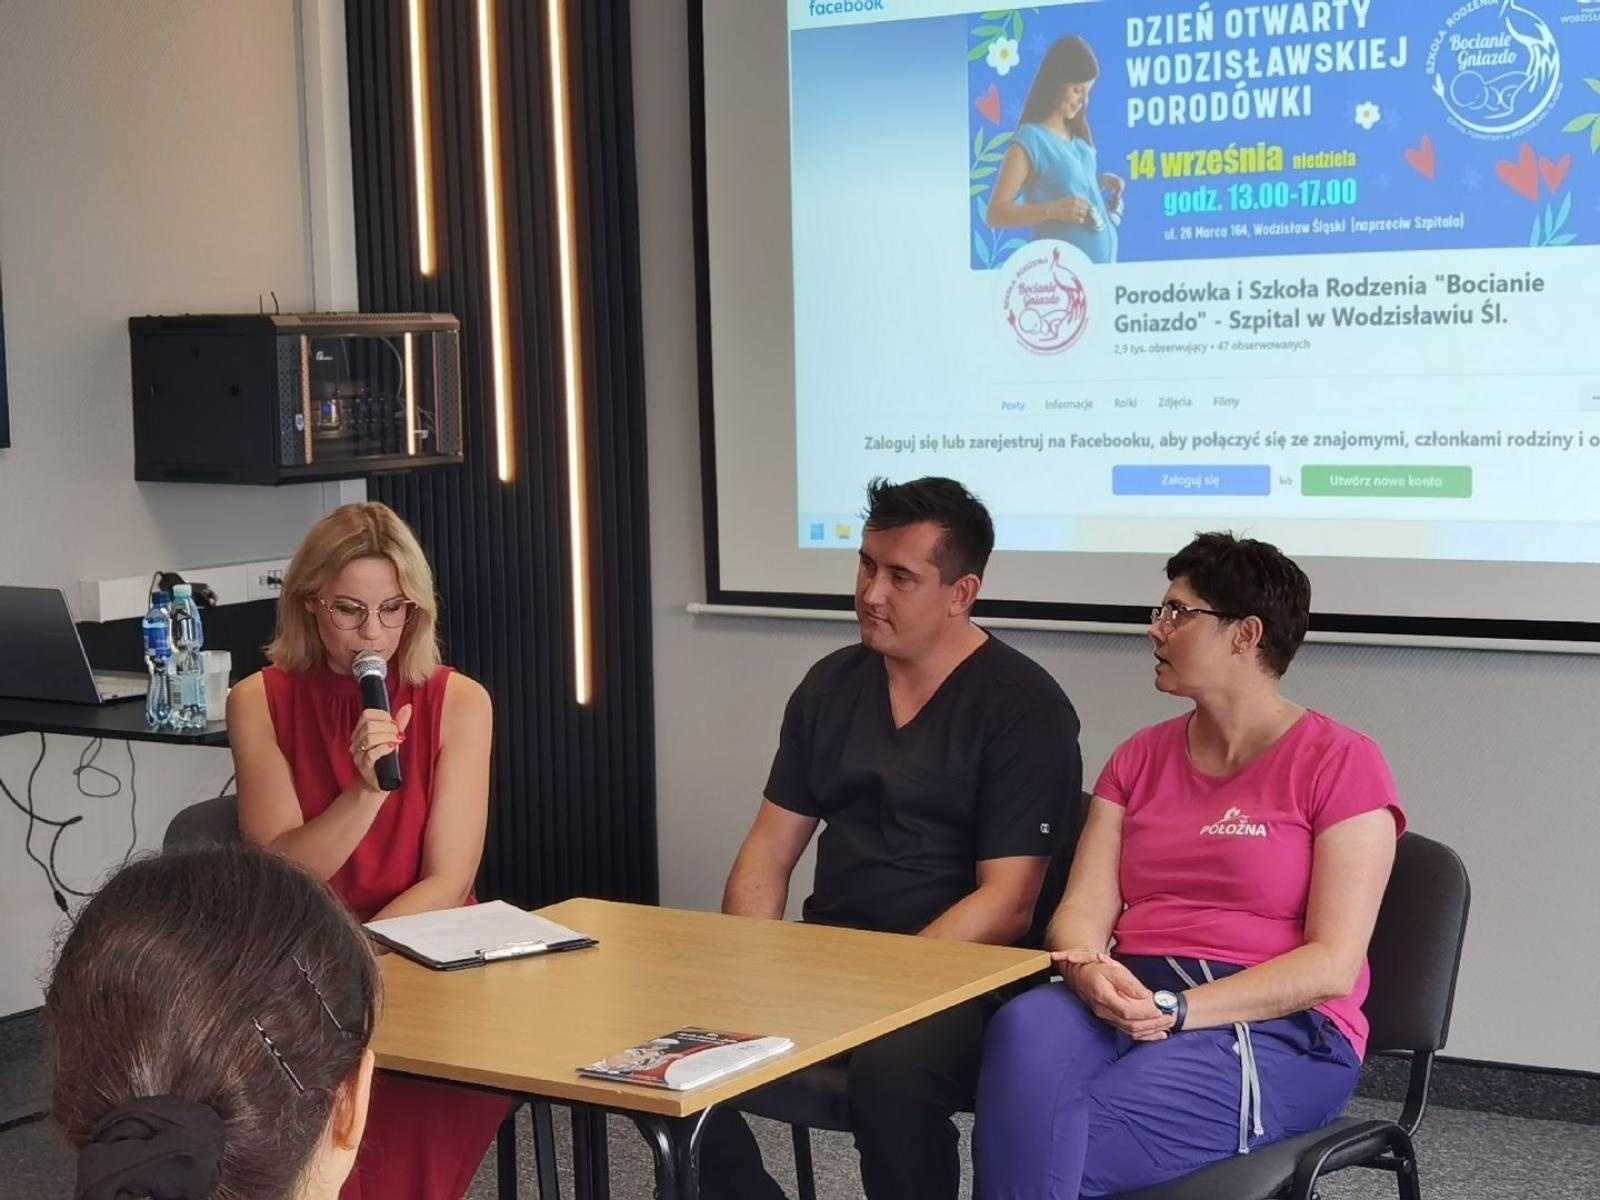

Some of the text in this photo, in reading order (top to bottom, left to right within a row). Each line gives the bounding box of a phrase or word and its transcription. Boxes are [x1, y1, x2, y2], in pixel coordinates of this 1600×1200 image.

[809, 0, 884, 16] facebook
[1127, 0, 1371, 47] DZIEŃ OTWARTY
[1449, 31, 1511, 51] Bocianie
[1126, 36, 1407, 87] WODZISŁAWSKIEJ
[1457, 49, 1517, 71] Gniazdo
[1127, 80, 1311, 128] PORODÓWKI
[1126, 142, 1356, 180] 14 września niedziela
[1163, 178, 1357, 216] godz. 13.00-17.00
[1164, 227, 1178, 240] ul.
[1180, 227, 1192, 239] 26
[1195, 225, 1227, 238] Marca
[1231, 224, 1251, 238] 164,
[1253, 220, 1310, 236] Wodzisław
[1312, 218, 1345, 235] Śląski
[1115, 272, 1545, 305] Porodówka i Szkoła Rodzenia "Bocianie
[1114, 311, 1207, 333] Gniazdo"
[1229, 308, 1299, 334] Szpital
[1307, 312, 1325, 327] w
[1332, 304, 1473, 327] Wodzisławiu
[1481, 299, 1508, 324] Śl.
[1130, 344, 1146, 355] tys.
[1148, 342, 1207, 355] obserwujący
[1217, 341, 1229, 351] 47
[1231, 339, 1310, 352] obserwowanych
[1001, 396, 1240, 412] Posty Informacje Rolki Zdjęcia Filmy
[864, 435, 915, 453] Zaloguj
[920, 435, 938, 452] się
[943, 434, 965, 449] lub
[969, 434, 1043, 452] zarejestruj
[1048, 438, 1066, 448] na
[1071, 432, 1155, 450] Facebooku,
[1159, 432, 1188, 450] aby
[1192, 431, 1260, 450] połączyć
[1265, 431, 1286, 449] się
[1290, 435, 1309, 447] ze
[1313, 430, 1409, 451] znajomymi,
[1414, 430, 1501, 447] członkami
[1507, 430, 1573, 451] rodziny
[1579, 430, 1583, 447] i
[1161, 474, 1219, 487] Zaloguj się
[1279, 475, 1293, 485] lub
[1329, 474, 1442, 487] Utwórz nowe konto
